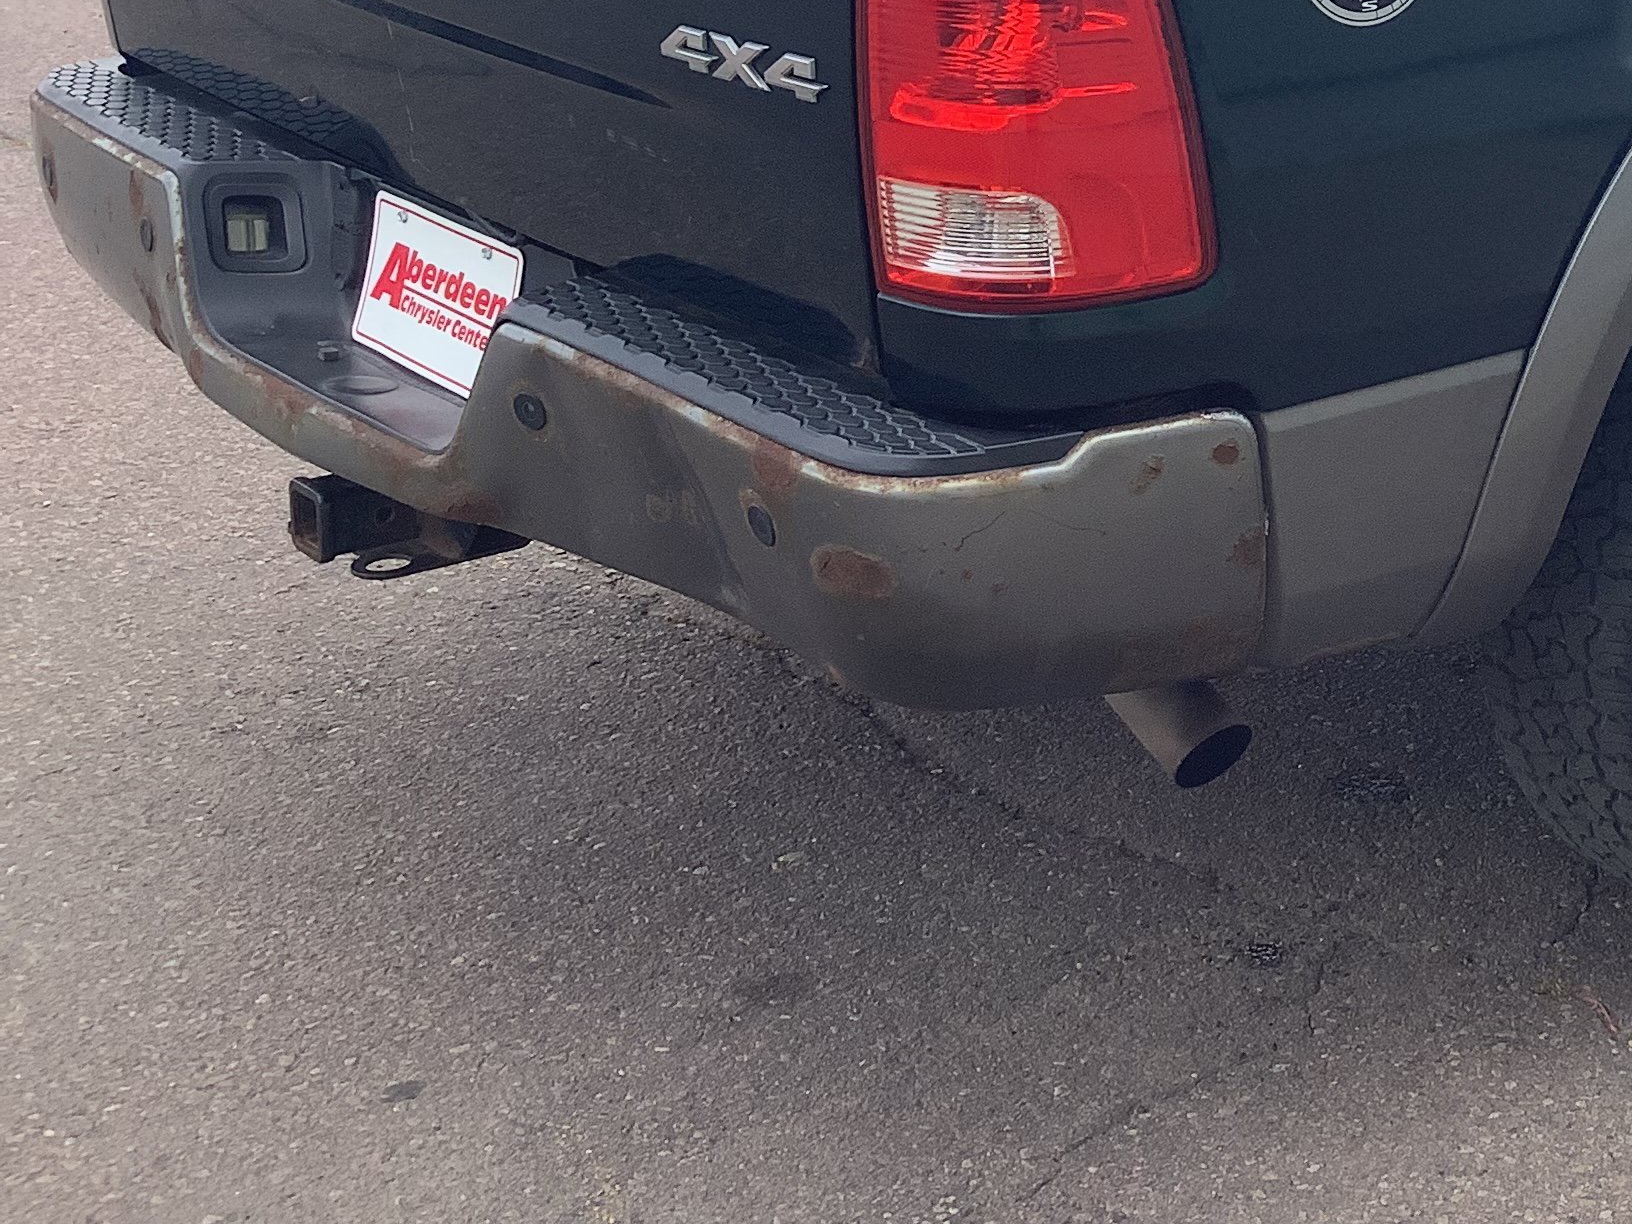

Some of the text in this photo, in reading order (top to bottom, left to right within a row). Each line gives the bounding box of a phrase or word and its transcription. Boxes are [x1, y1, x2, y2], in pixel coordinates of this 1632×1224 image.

[1361, 0, 1378, 12] S
[370, 241, 508, 320] Aberdeen
[400, 294, 489, 352] Chrysler Cente
